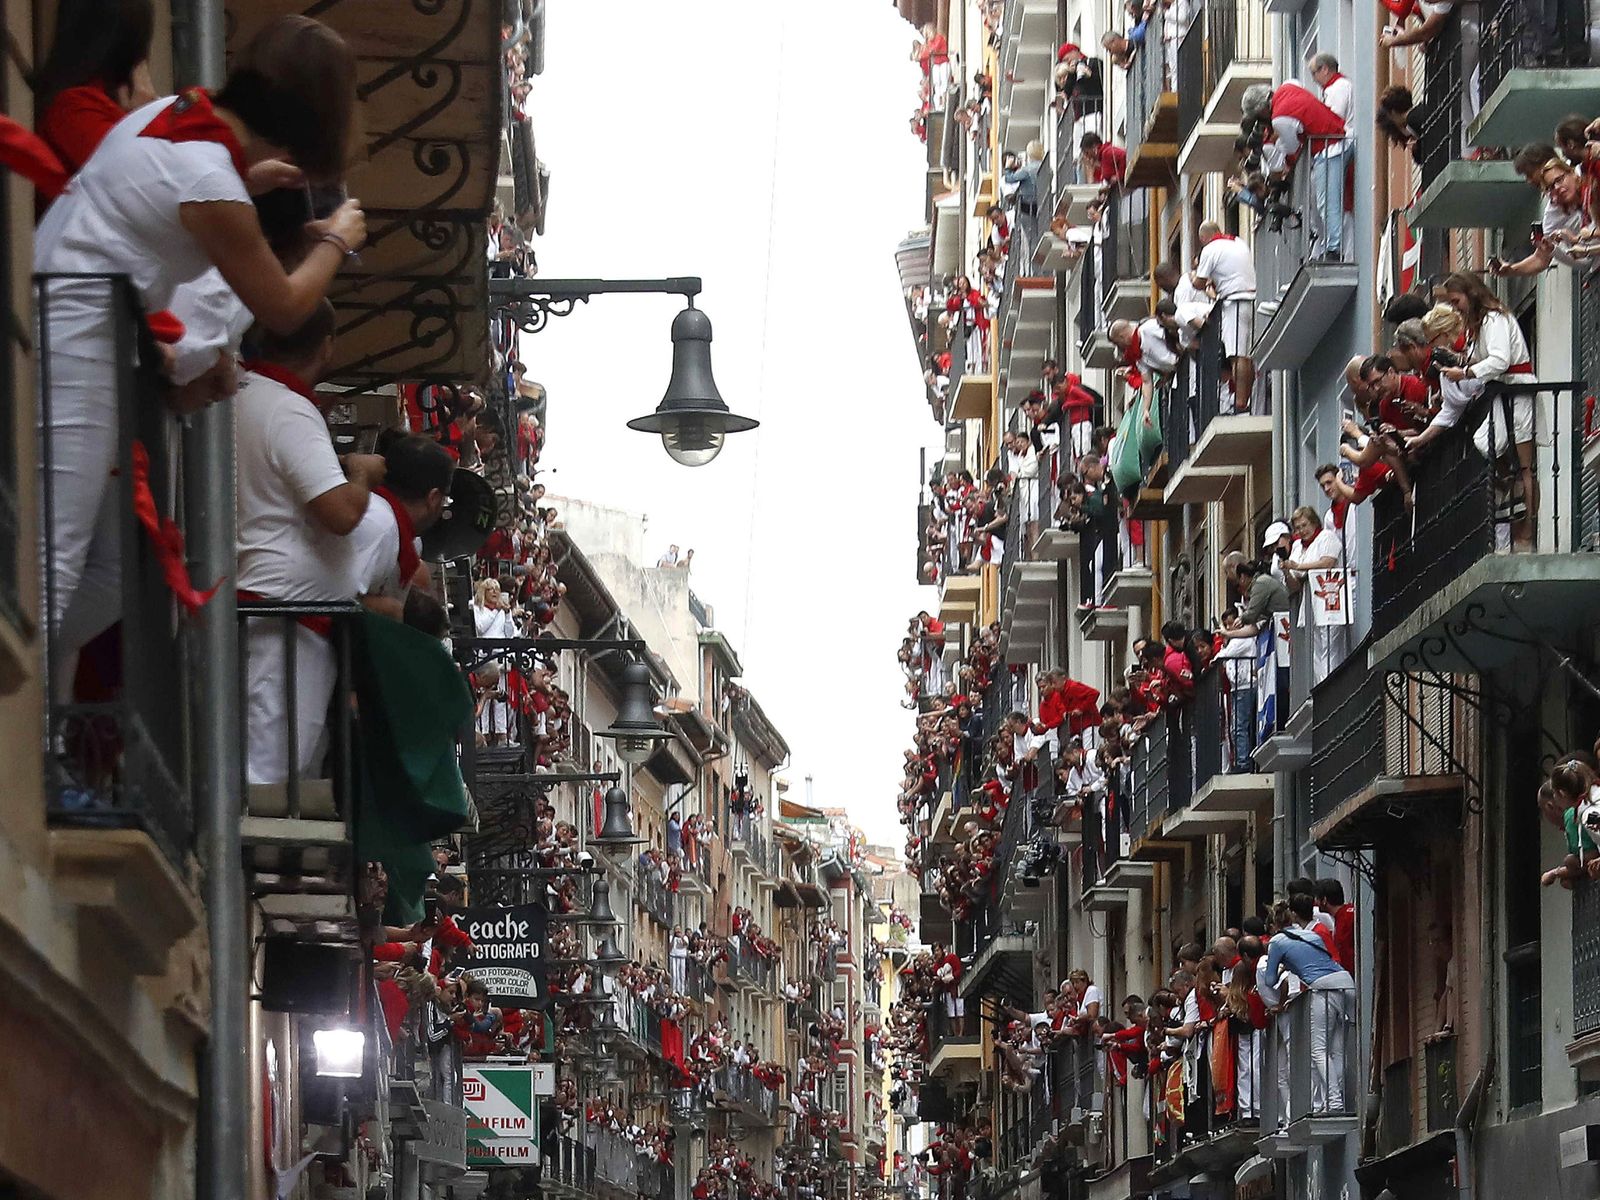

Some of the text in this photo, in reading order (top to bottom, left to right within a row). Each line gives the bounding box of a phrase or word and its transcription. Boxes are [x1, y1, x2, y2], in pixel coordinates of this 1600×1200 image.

[467, 942, 539, 960] OTOGRAFO
[508, 978, 530, 987] COLOR
[496, 986, 530, 996] MATERIAL
